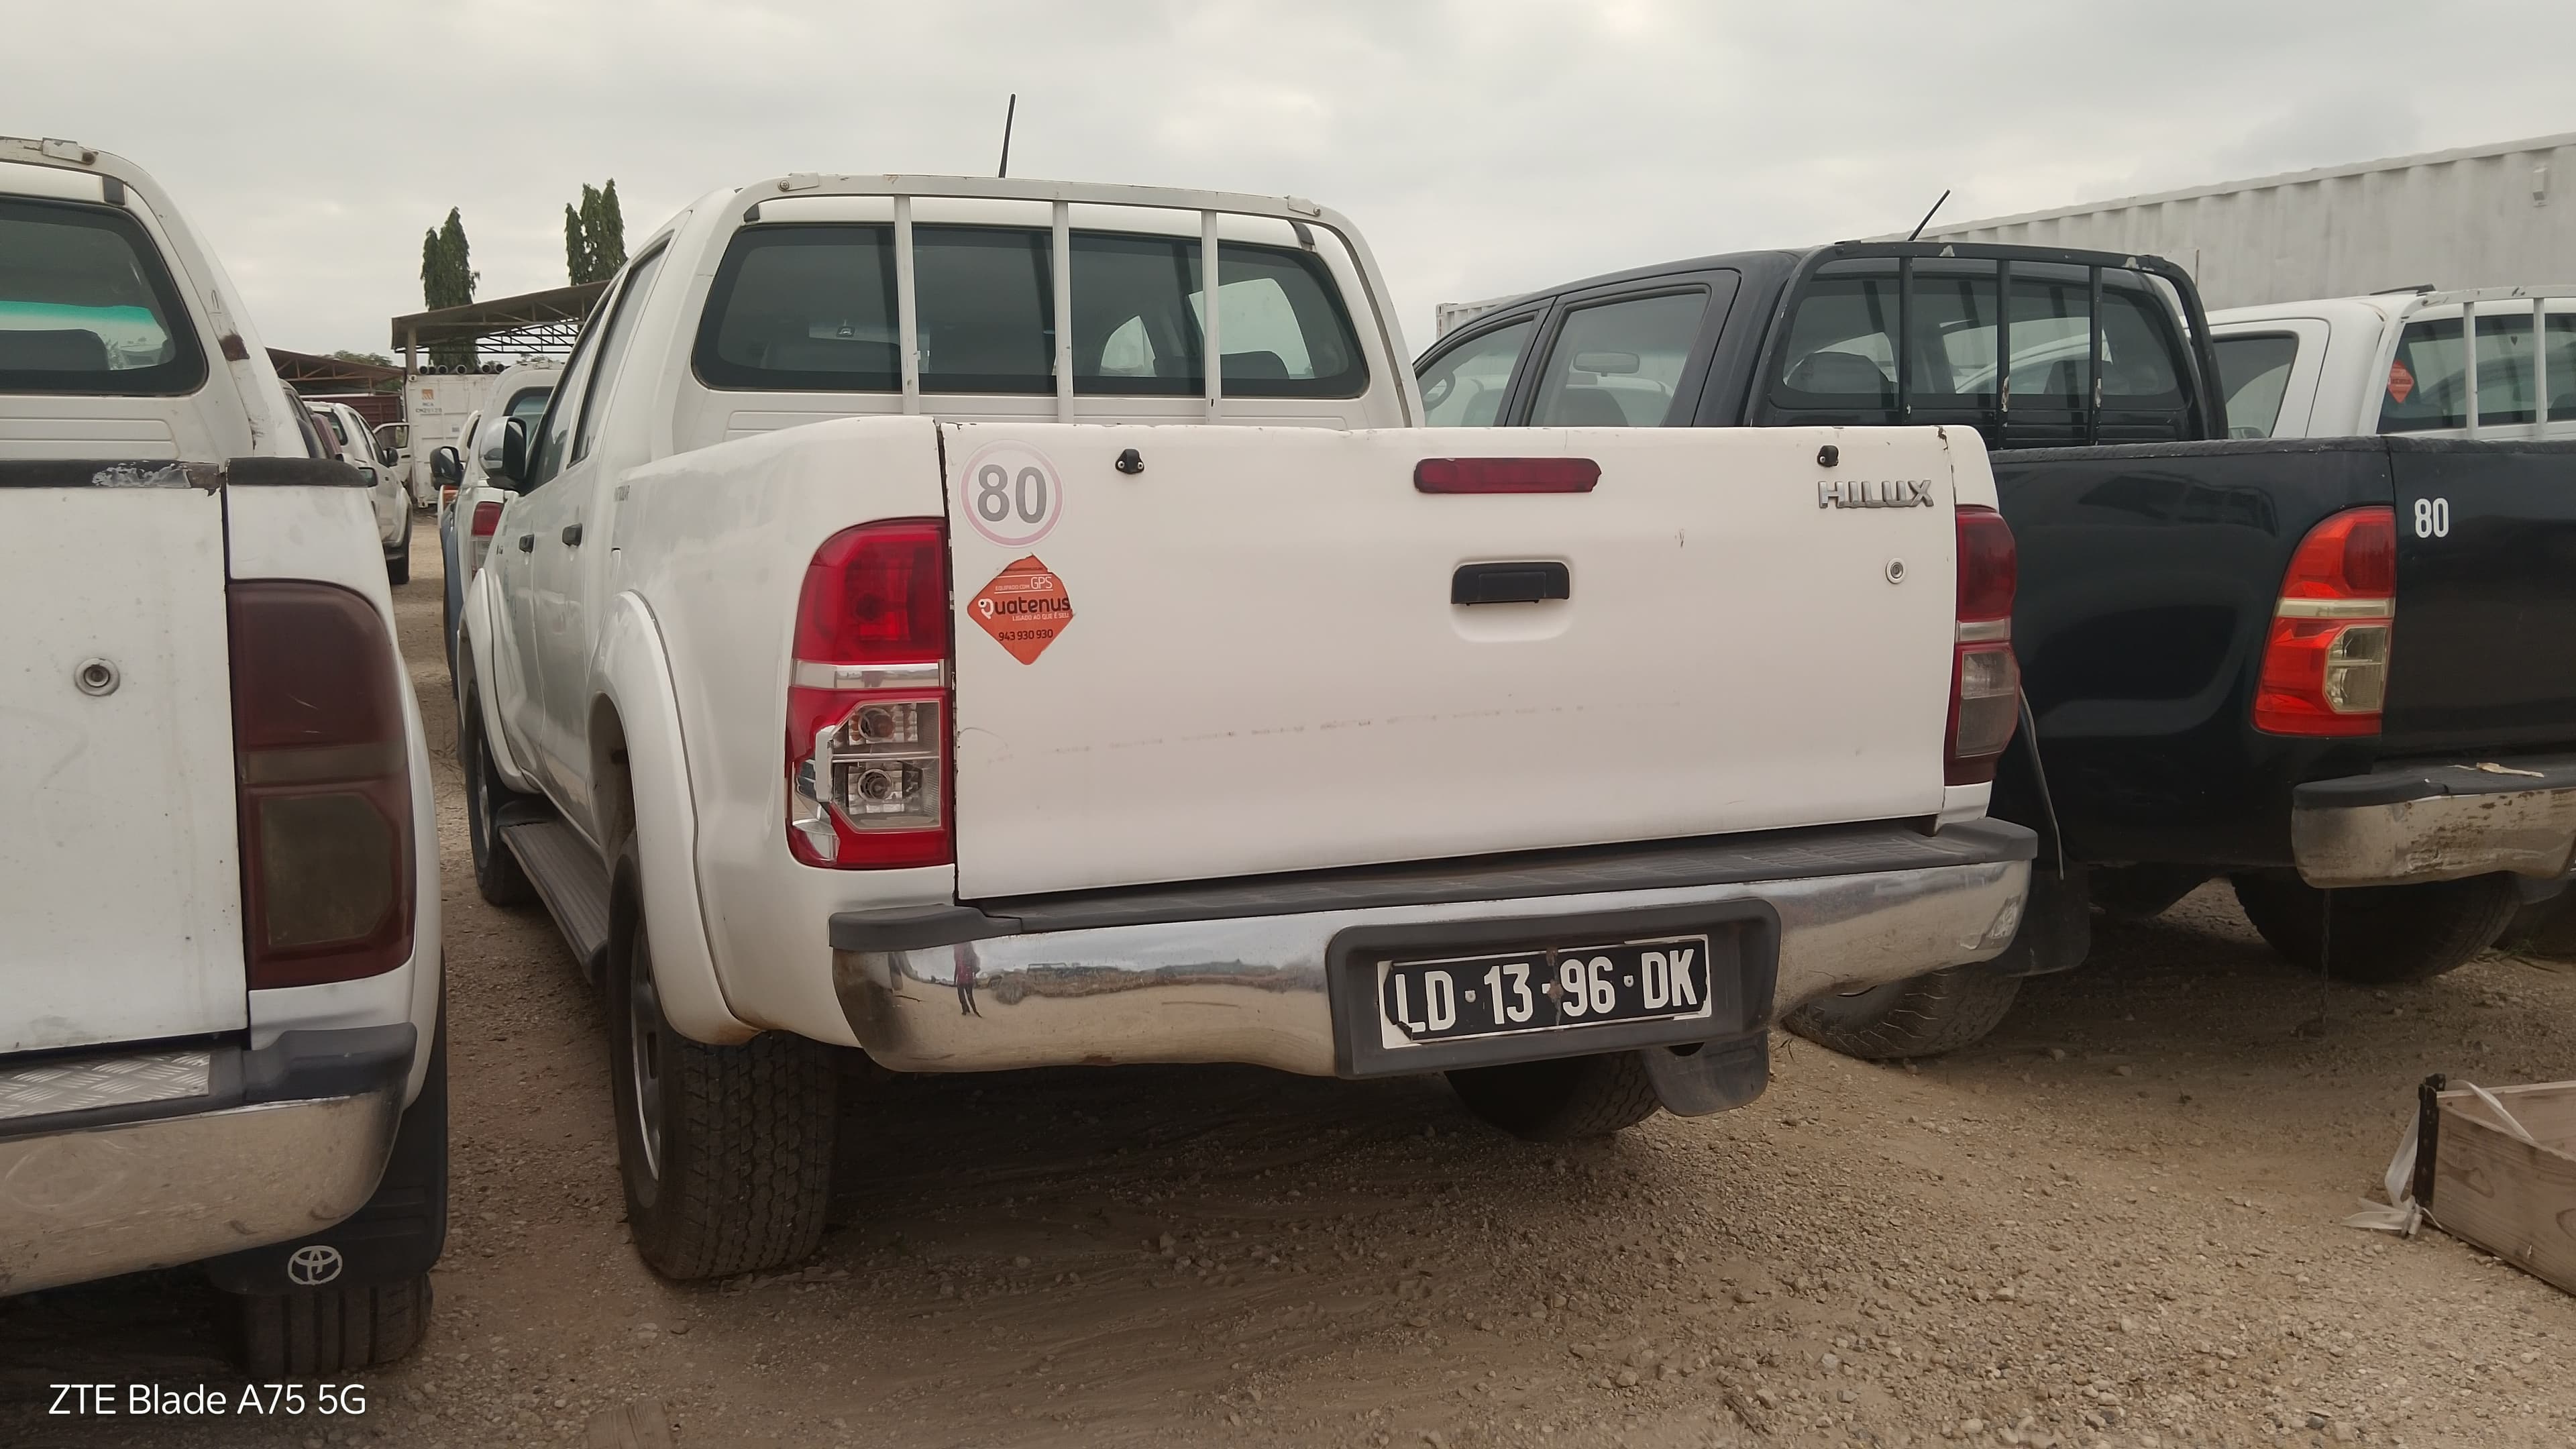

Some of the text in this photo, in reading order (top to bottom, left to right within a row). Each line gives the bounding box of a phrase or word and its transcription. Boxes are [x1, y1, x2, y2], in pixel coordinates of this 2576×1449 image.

[977, 464, 1047, 523] 80
[1818, 480, 1934, 508] HILUX
[2415, 498, 2449, 537] 80
[1030, 576, 1053, 589] GPS
[998, 629, 1053, 641] 943 930 930
